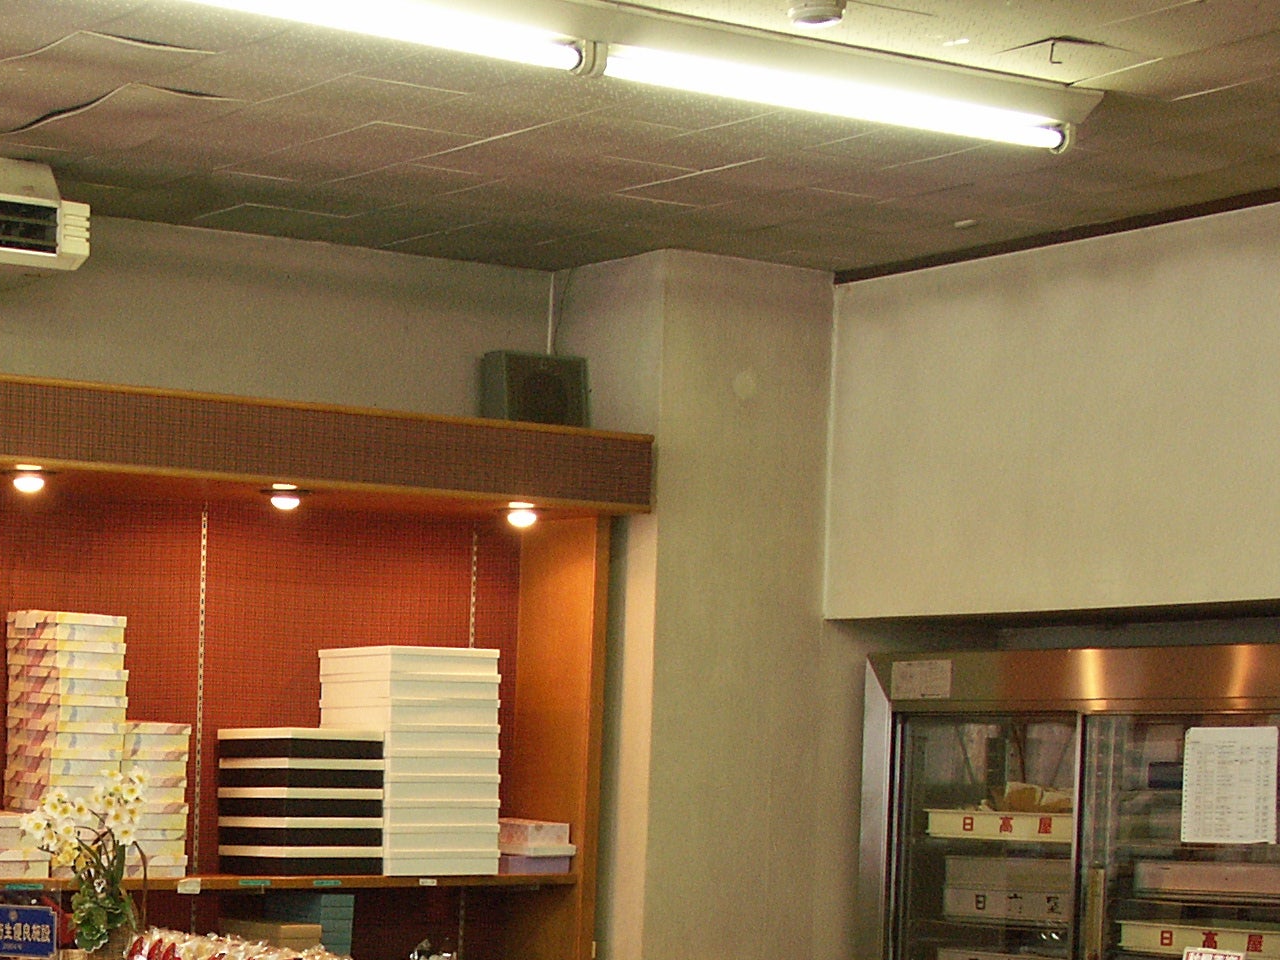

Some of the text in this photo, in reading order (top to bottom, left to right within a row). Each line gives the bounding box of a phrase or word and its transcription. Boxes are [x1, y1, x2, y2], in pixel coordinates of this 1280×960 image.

[963, 816, 1053, 834] 日高屋
[1160, 930, 1264, 953] 日高屋
